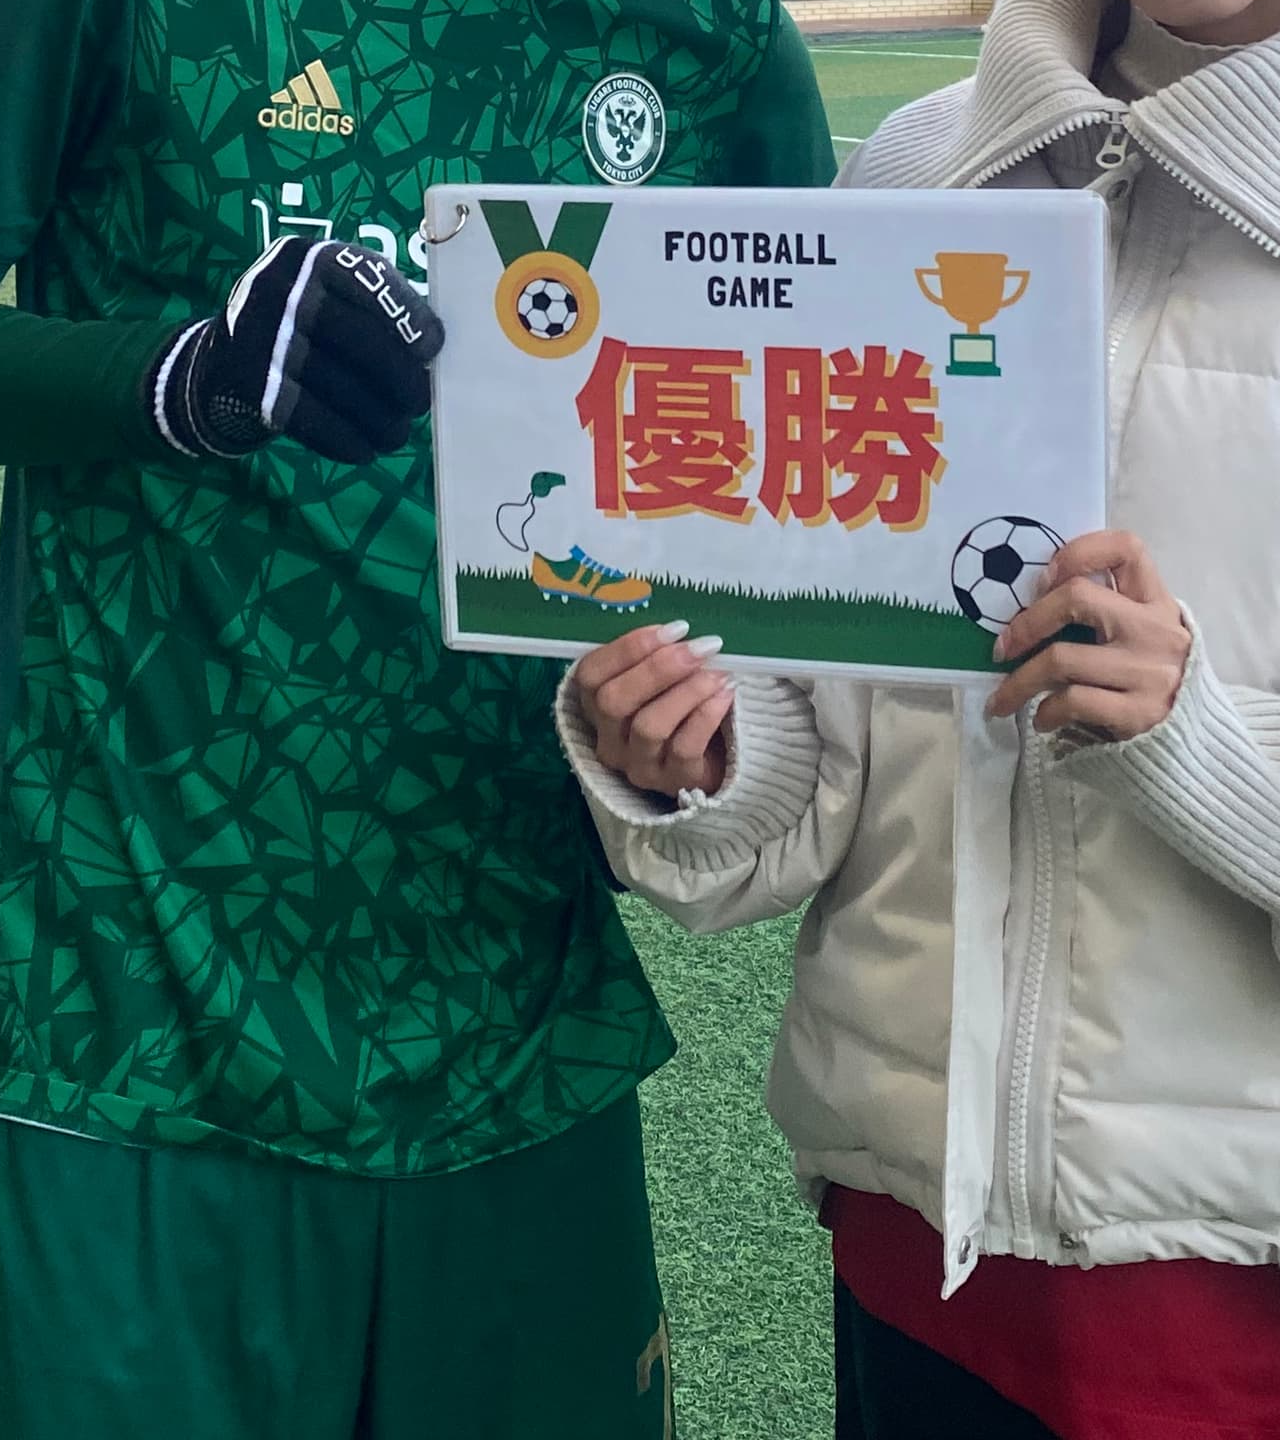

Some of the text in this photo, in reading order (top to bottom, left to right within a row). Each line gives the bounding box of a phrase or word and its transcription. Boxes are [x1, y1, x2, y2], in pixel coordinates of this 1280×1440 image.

[588, 79, 661, 119] LIGARE FOOTBALL CLUB
[257, 103, 355, 136] adidas
[602, 160, 644, 180] TOKYO CITY
[664, 231, 837, 266] FOOTBALL
[707, 275, 793, 309] GAME
[575, 336, 948, 533] 優勝
